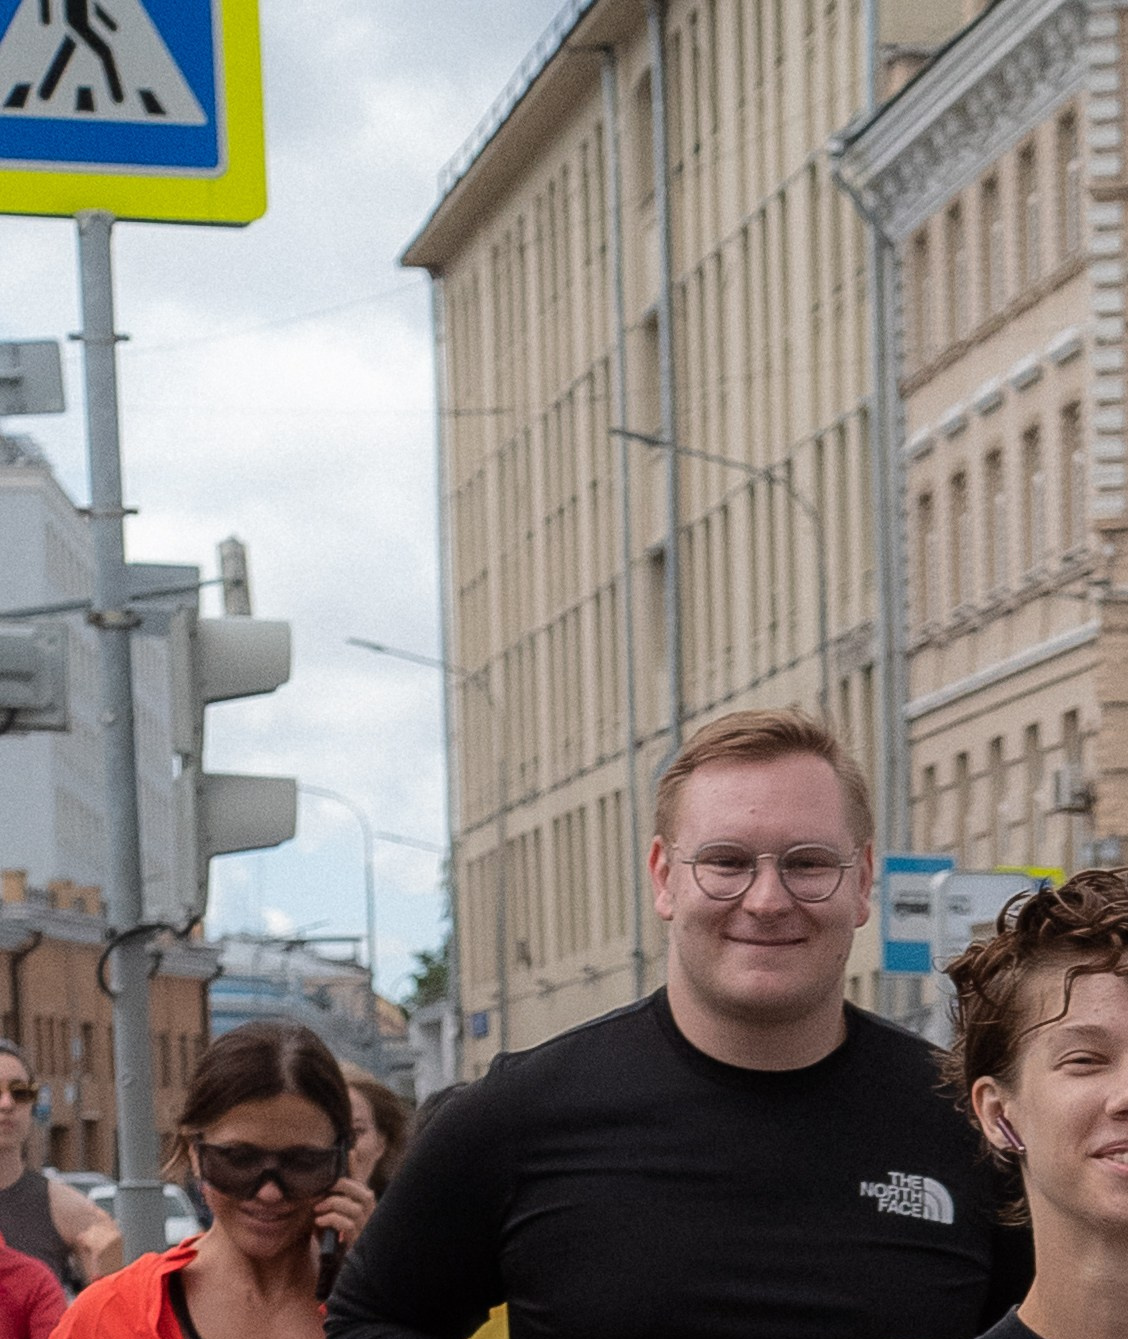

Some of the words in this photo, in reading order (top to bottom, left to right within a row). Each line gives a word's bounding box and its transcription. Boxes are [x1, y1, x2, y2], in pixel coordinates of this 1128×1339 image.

[888, 1171, 922, 1190] THE
[860, 1181, 922, 1202] NORTH
[878, 1198, 922, 1218] FACE
